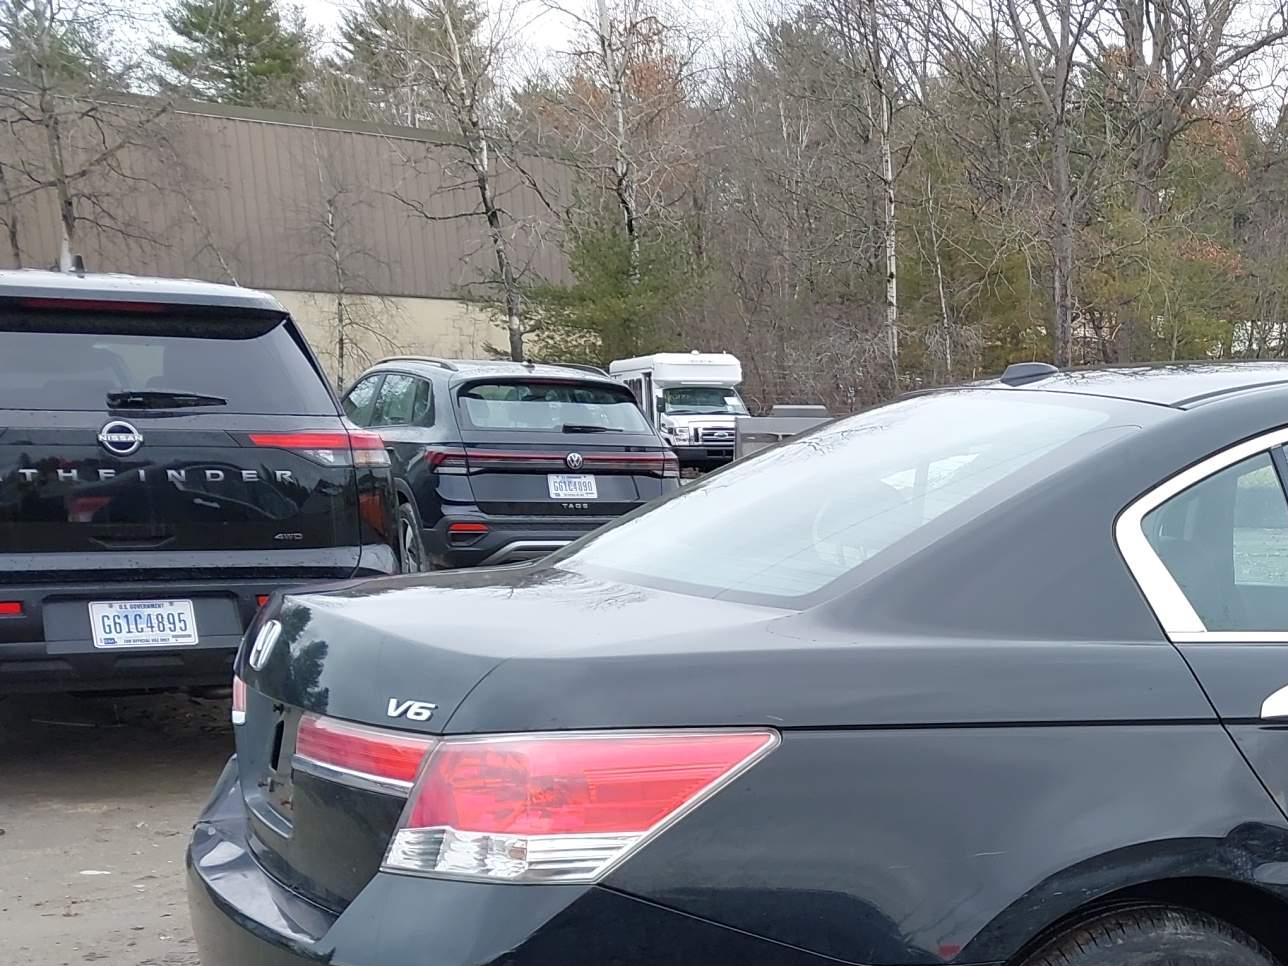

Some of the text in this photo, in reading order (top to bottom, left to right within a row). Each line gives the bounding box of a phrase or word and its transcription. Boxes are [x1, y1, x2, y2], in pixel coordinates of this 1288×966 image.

[99, 434, 143, 442] NISSAN
[0, 469, 297, 483] THFINDER
[101, 612, 188, 635] G61C4895
[387, 698, 436, 721] V6
